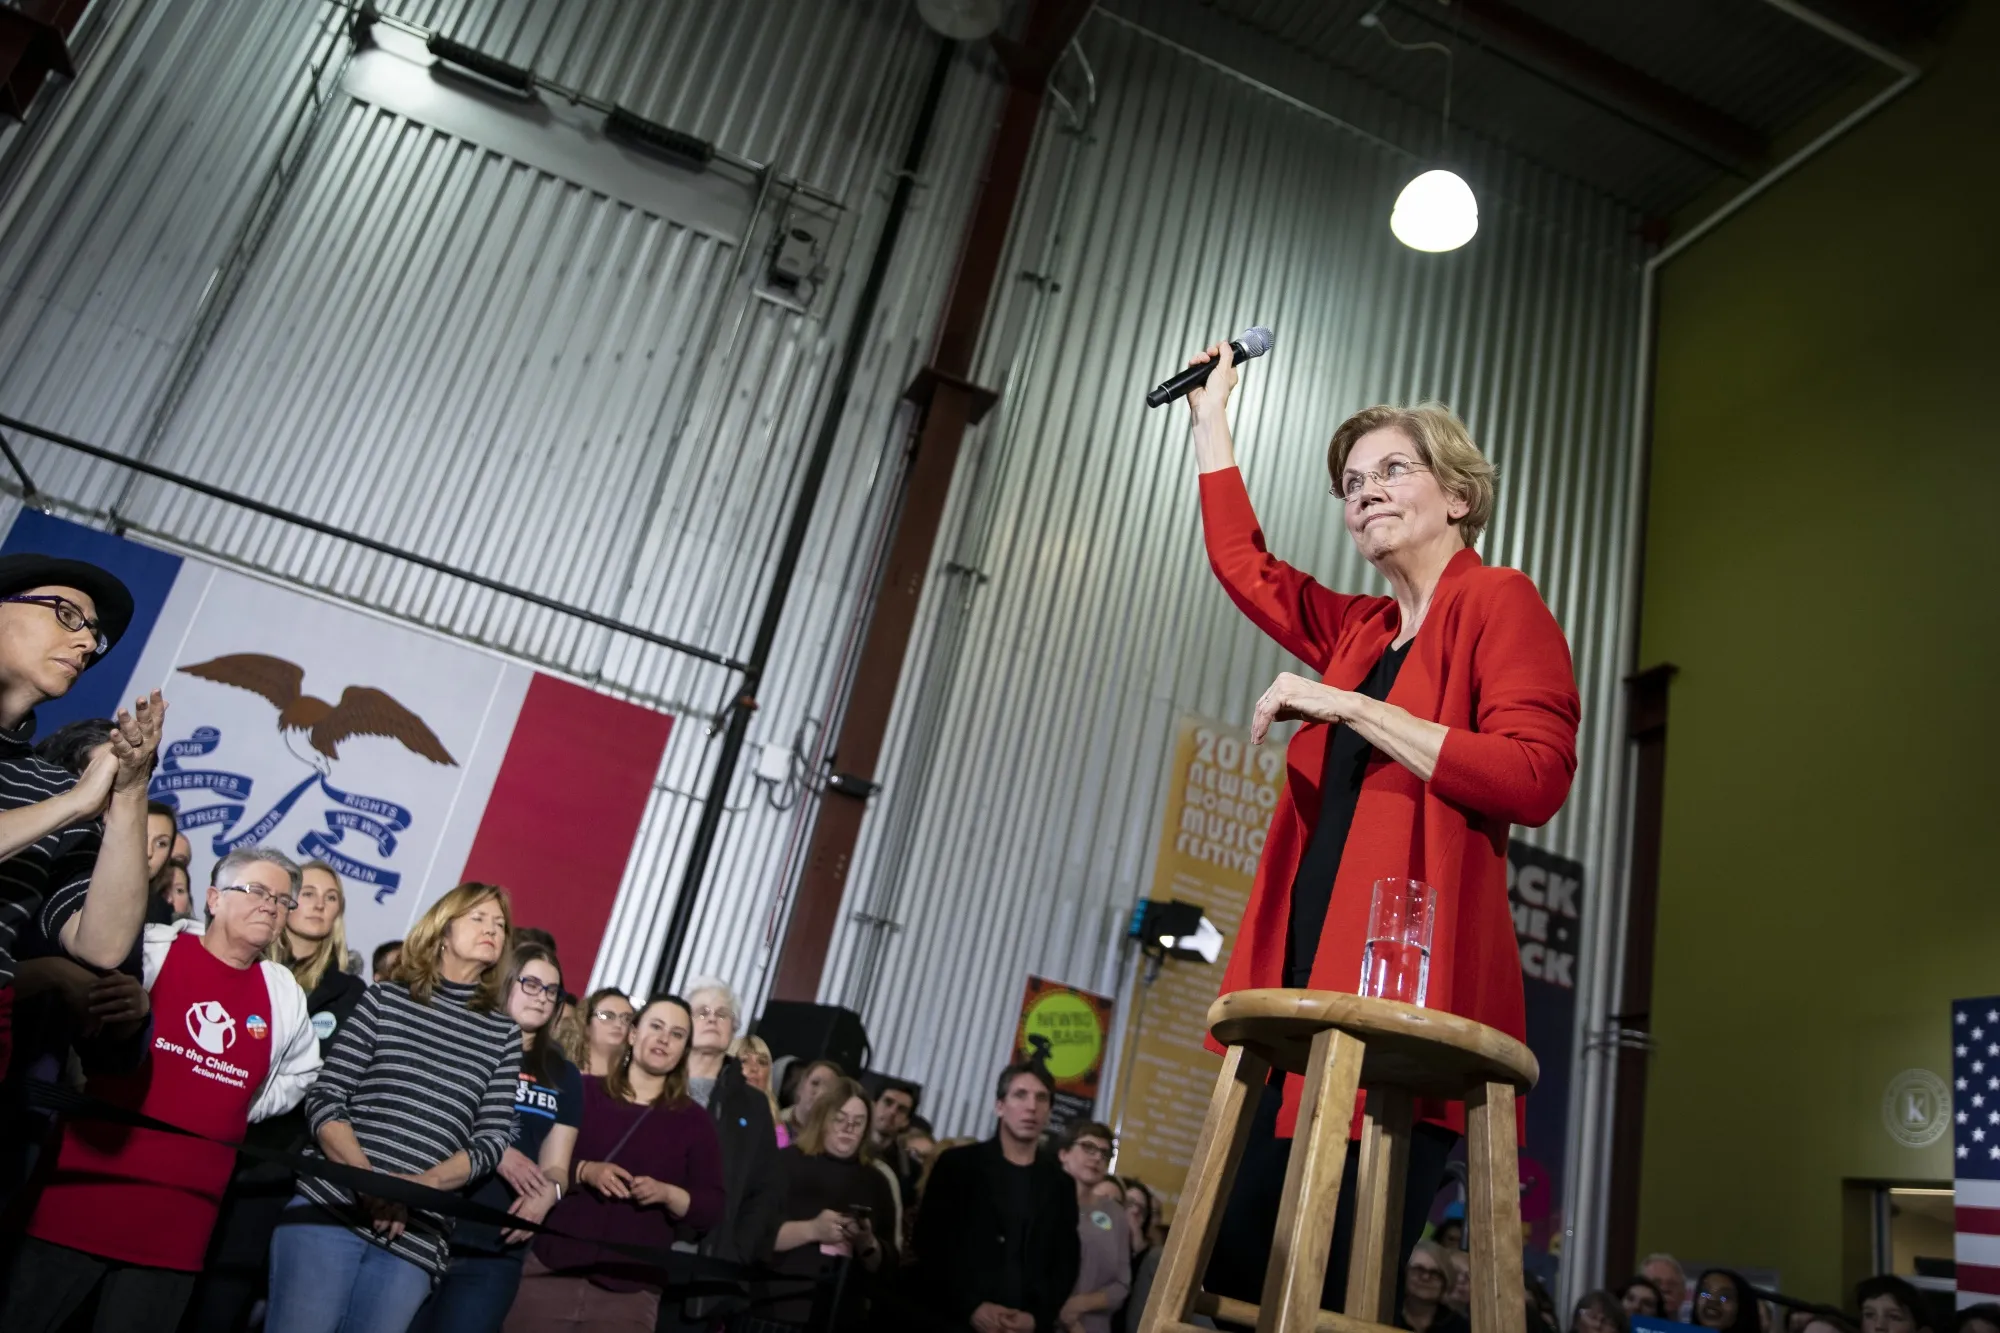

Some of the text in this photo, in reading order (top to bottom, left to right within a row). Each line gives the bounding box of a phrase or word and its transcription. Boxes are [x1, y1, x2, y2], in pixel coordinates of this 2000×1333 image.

[171, 743, 203, 756] OUR
[1196, 729, 1281, 784] 2019
[157, 774, 240, 791] LIBERTIES
[186, 807, 229, 826] PRIZE
[344, 794, 399, 819] RIGHTS
[254, 810, 281, 837] OUR
[336, 812, 390, 846] WE WILL
[1182, 807, 1267, 854] MUSIC
[311, 844, 378, 883] MAINTAIN
[155, 1037, 249, 1078] Save the Children
[192, 1065, 215, 1079] Action
